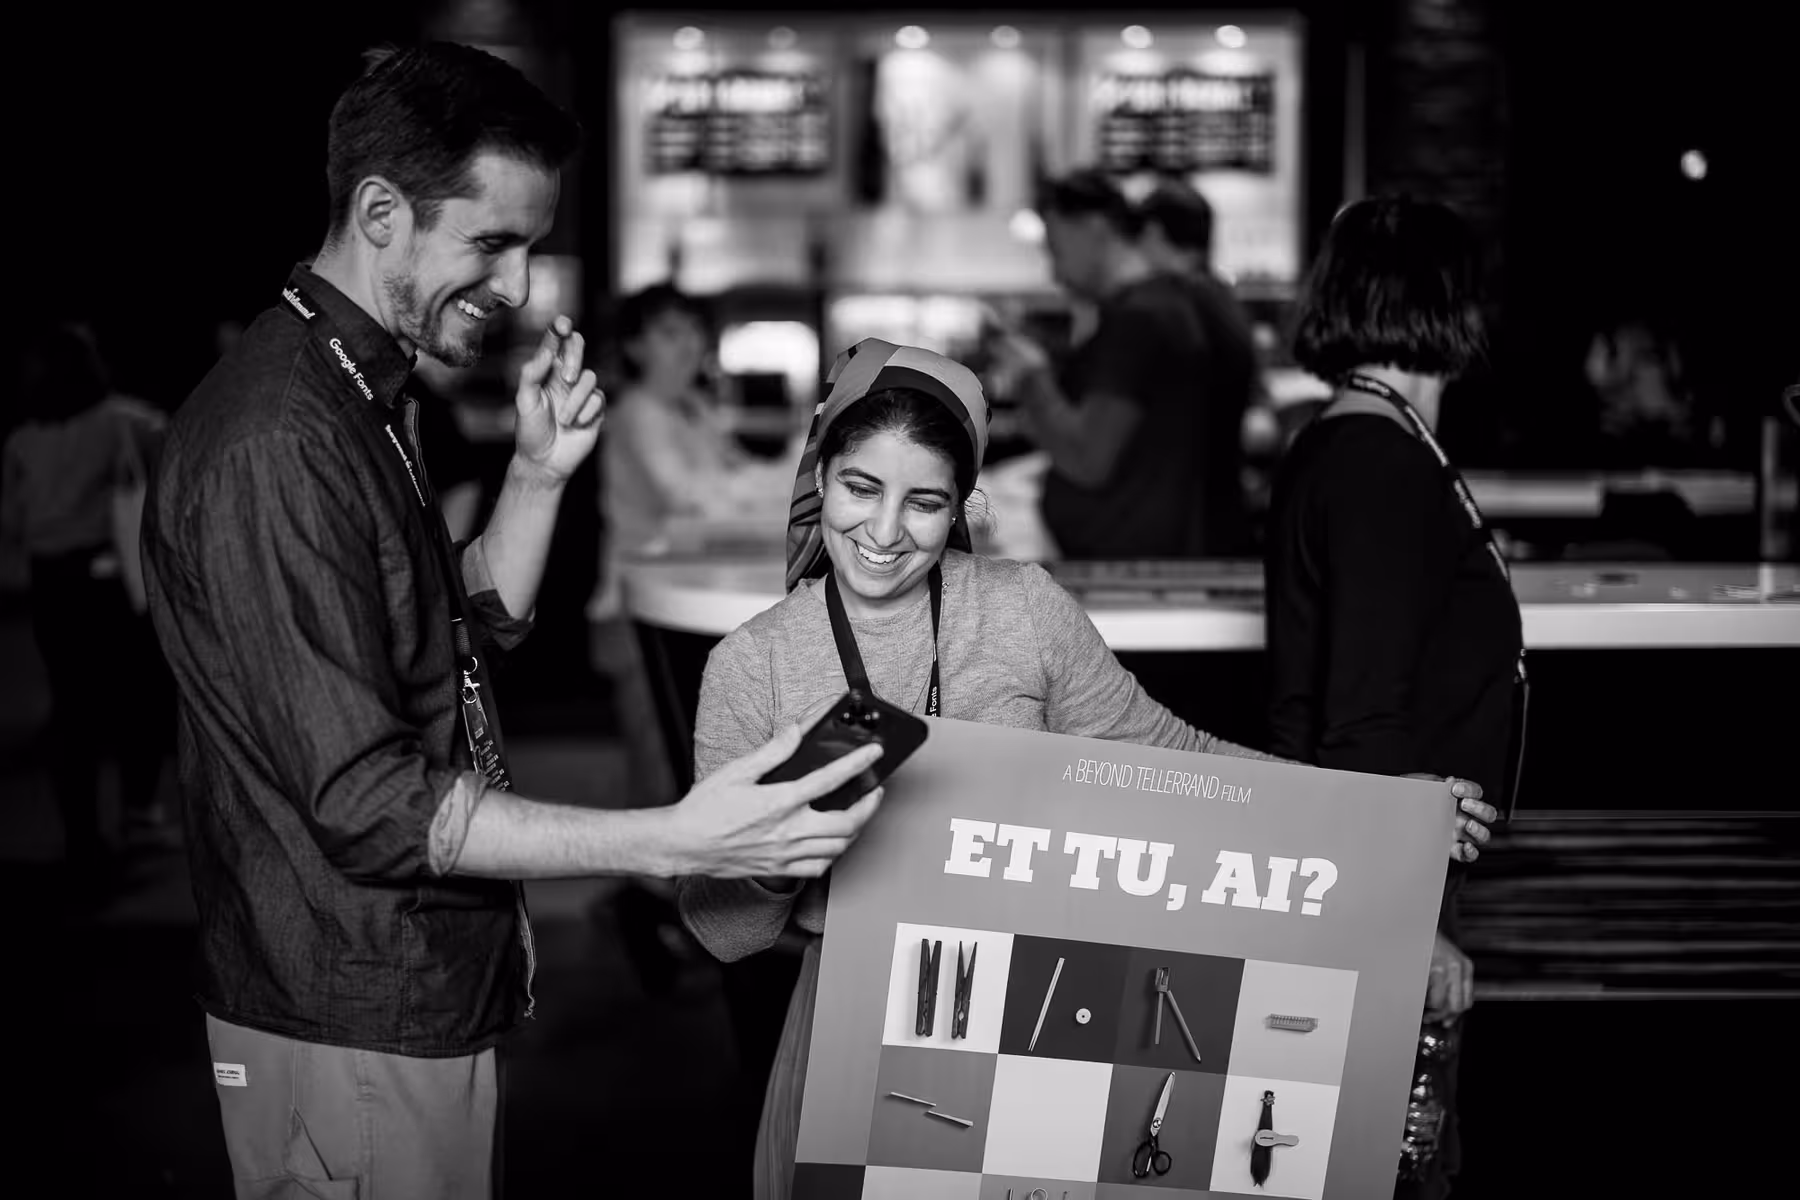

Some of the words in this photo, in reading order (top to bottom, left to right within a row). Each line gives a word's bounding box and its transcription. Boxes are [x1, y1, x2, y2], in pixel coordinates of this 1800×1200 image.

[329, 338, 357, 374] Google
[353, 372, 374, 401] Fonts
[929, 686, 938, 713] Fonts
[1062, 764, 1072, 782] A
[1075, 758, 1133, 788] BEYOND
[1136, 766, 1220, 799] TELLERRAND
[1220, 784, 1252, 804] FILM
[944, 817, 1052, 883] ET
[1063, 831, 1188, 911] TU,
[1201, 850, 1338, 917] AI?
